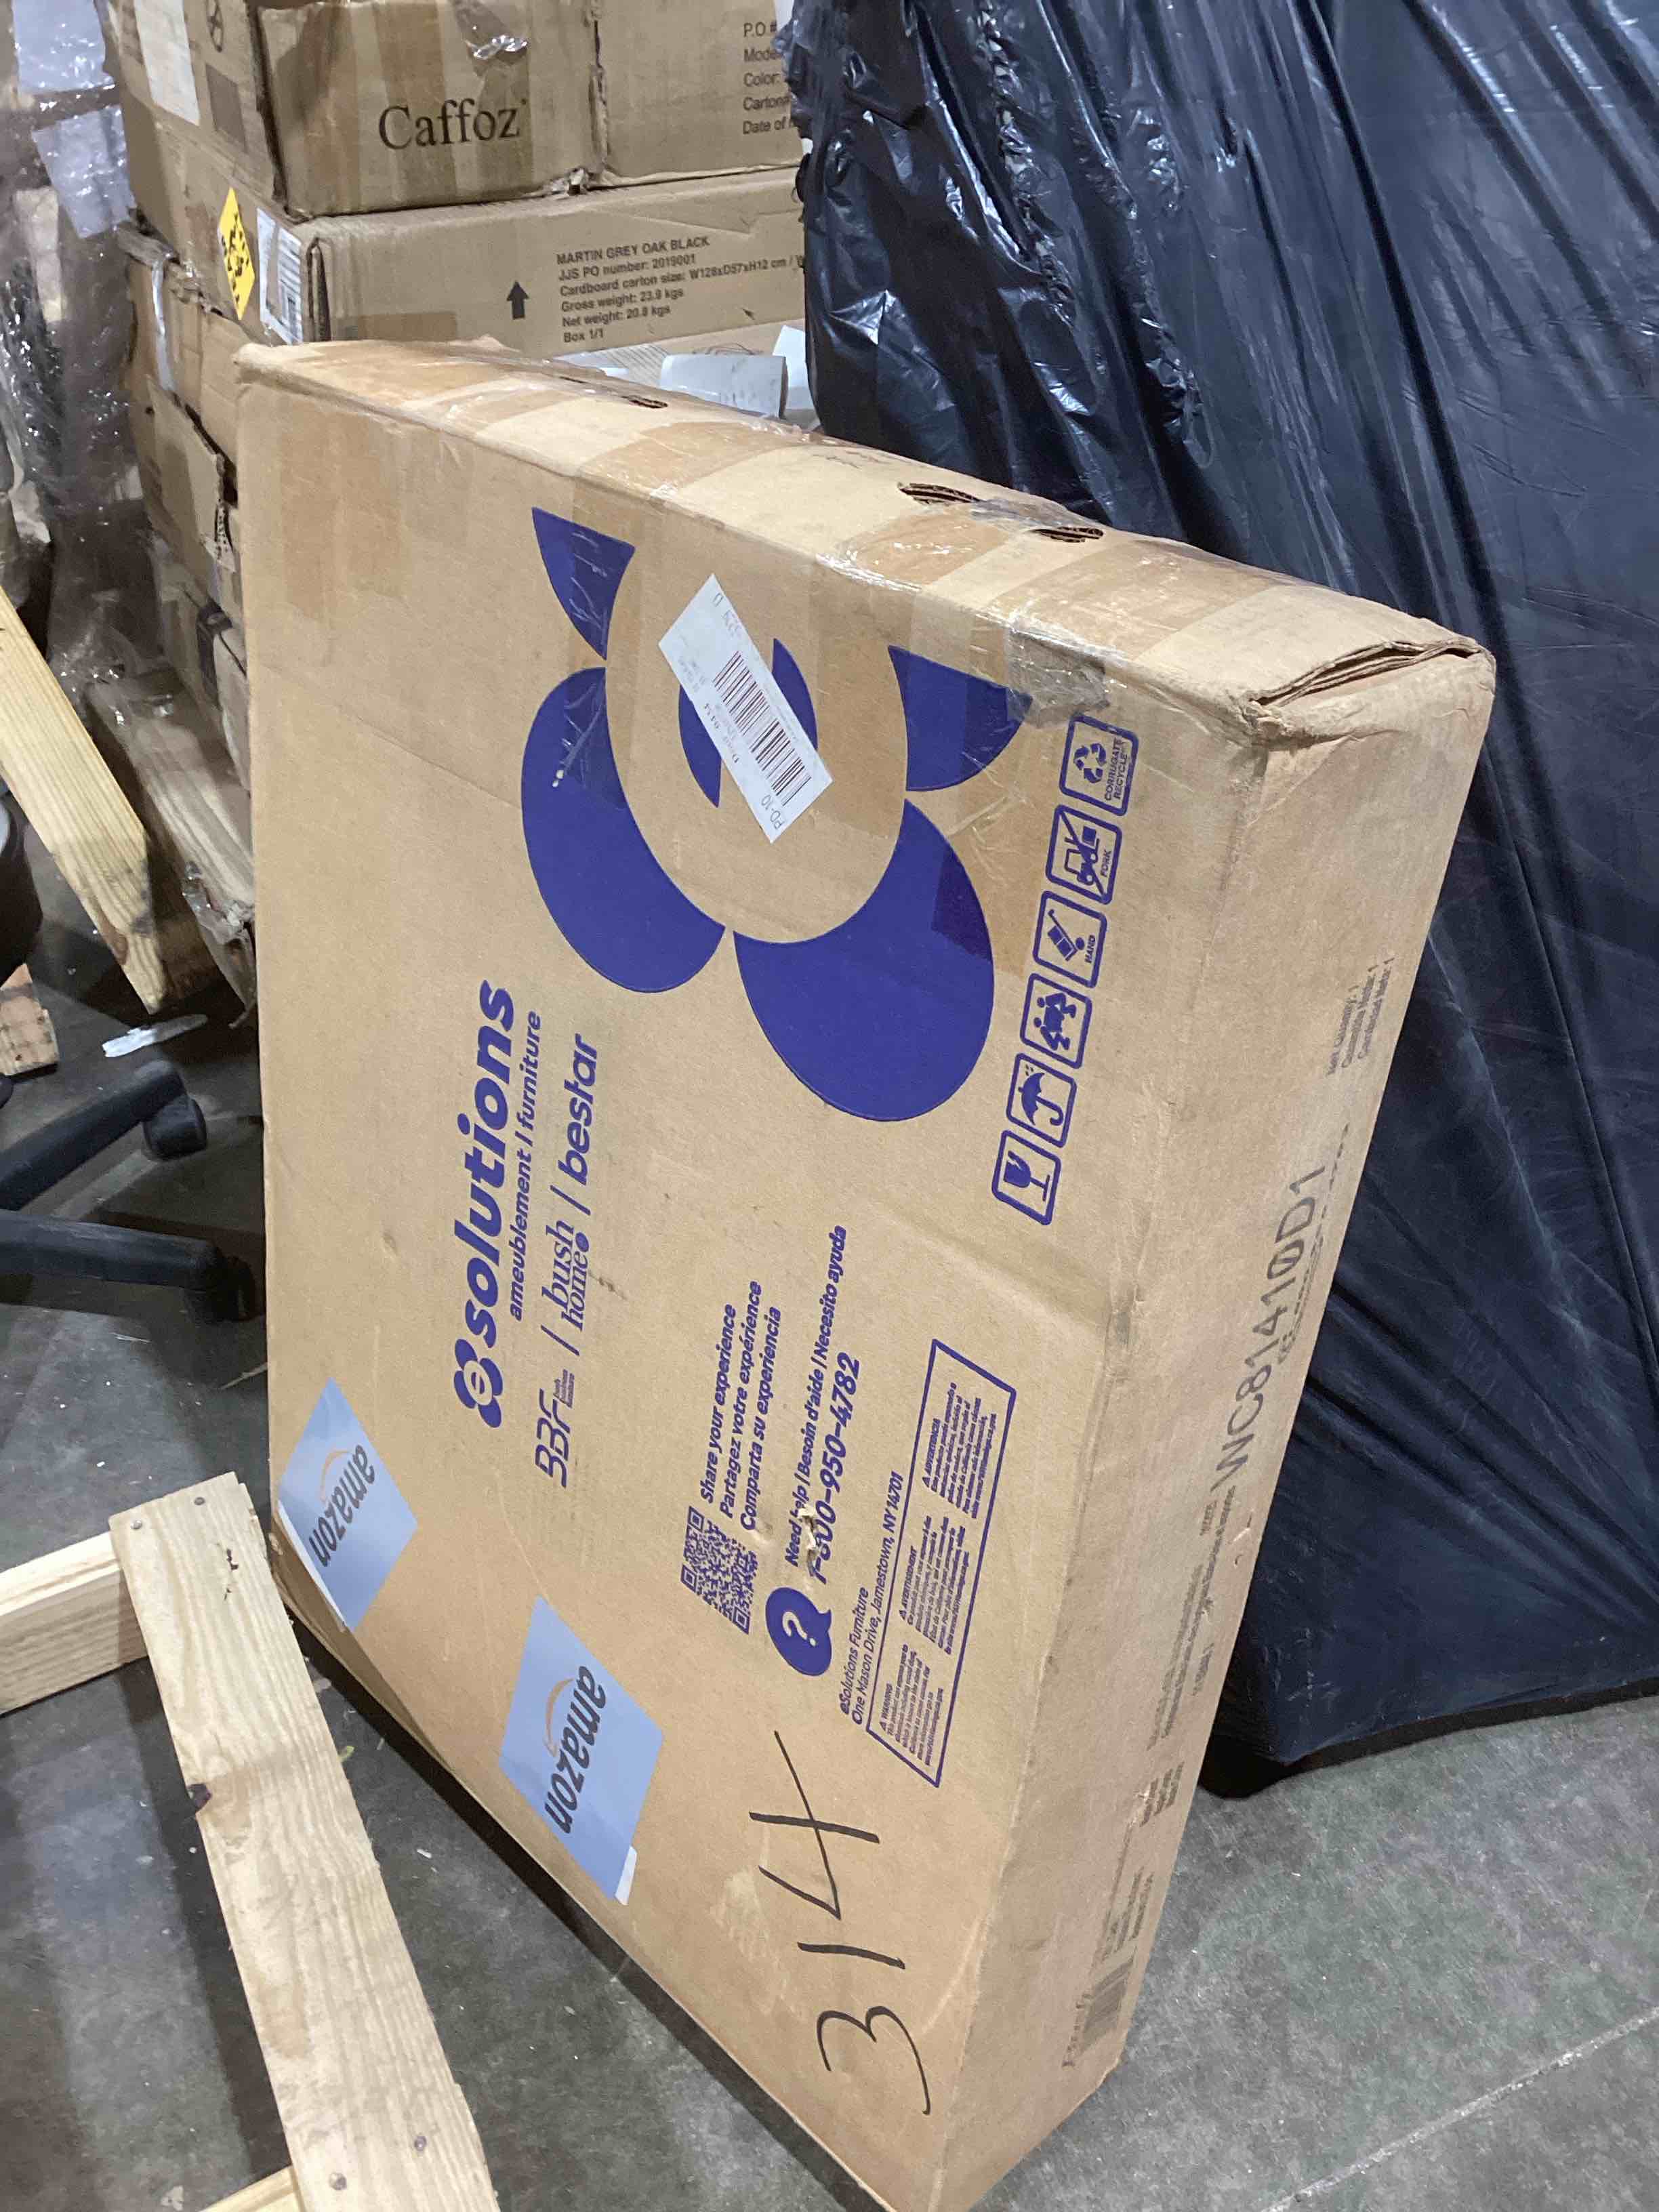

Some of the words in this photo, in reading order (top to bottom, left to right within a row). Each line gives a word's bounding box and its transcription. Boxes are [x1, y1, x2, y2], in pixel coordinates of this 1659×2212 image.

[379, 97, 520, 150] Caffoz
[743, 120, 771, 135] Date
[774, 116, 787, 131] of
[556, 248, 603, 265] MARTIN
[606, 243, 638, 260] GREY
[642, 241, 668, 255] OAK
[670, 236, 710, 250] BLACK
[560, 279, 619, 296] Cardboard
[622, 275, 659, 289] carton
[561, 298, 595, 312] Gross
[562, 316, 581, 327] Net
[563, 331, 586, 343] Box
[516, 1010, 542, 1132] furniture
[558, 1033, 598, 1187] bestar
[510, 1147, 534, 1322] ameublement
[828, 1225, 847, 1284] ayuda
[541, 1219, 575, 1311] bush
[561, 1250, 589, 1332] home
[739, 1281, 762, 1385] expérience
[813, 1283, 838, 1361] Necesito
[715, 1303, 737, 1406] experience
[757, 1306, 781, 1415] experiencia
[732, 1387, 747, 1435] votre
[804, 1368, 825, 1421] d'aide
[709, 1405, 723, 1454] your
[754, 1416, 766, 1441] su
[797, 1421, 817, 1478] Besoin
[700, 1451, 718, 1504] Share
[720, 1436, 741, 1519] Partagez
[740, 1441, 763, 1531] Comparta
[886, 1470, 904, 1511] 14701
[308, 1444, 375, 1567] amazon
[883, 1508, 897, 1534] NY
[785, 1519, 802, 1568] Need
[870, 1536, 896, 1616] Jamestown,
[838, 1647, 859, 1715] eSolutions
[849, 1587, 869, 1648] Furniture
[863, 1616, 882, 1654] Drive,
[856, 1653, 873, 1697] Mason
[851, 1696, 866, 1725] One
[544, 1665, 607, 1834] amazon
[748, 1729, 931, 2116] 314
